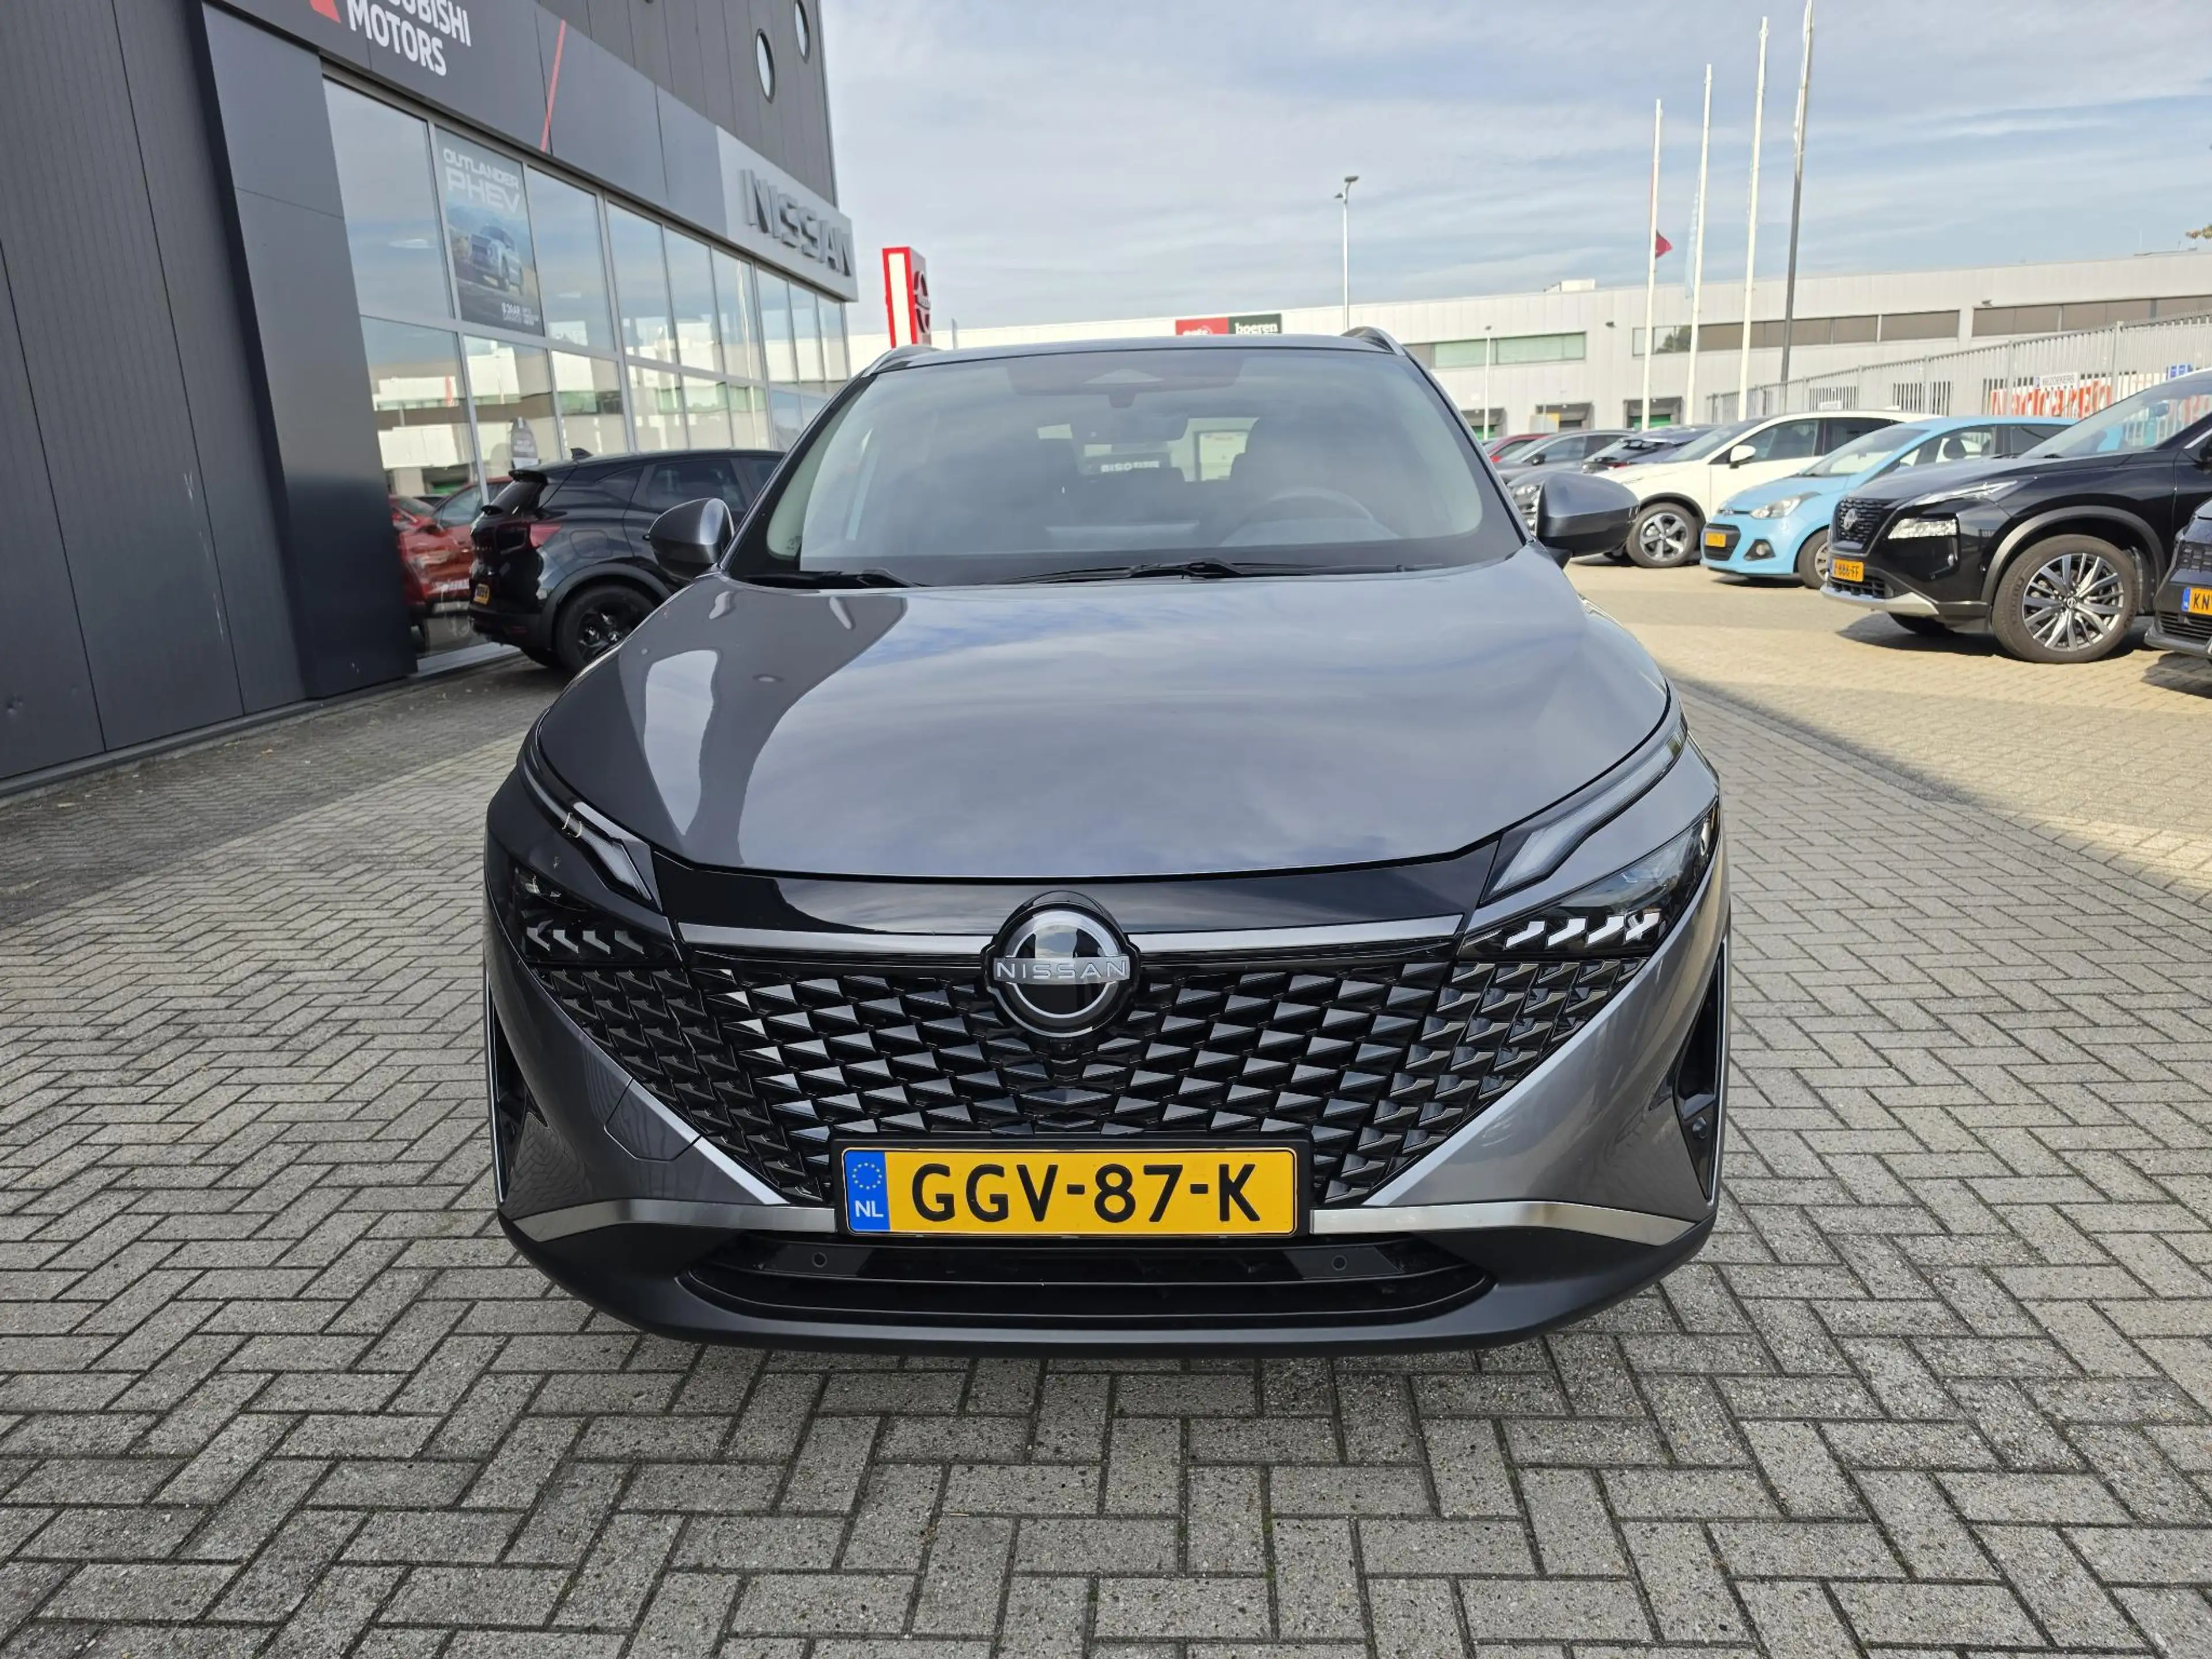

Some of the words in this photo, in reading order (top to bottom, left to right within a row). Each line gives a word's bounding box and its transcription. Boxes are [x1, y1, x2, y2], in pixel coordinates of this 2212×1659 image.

[347, 0, 447, 77] MOTORS
[443, 147, 520, 190] OUTLANDER
[445, 166, 521, 214] PHEV
[739, 169, 852, 277] NISSAN
[2193, 592, 2212, 611] KN
[995, 959, 1127, 980] NISSAN
[854, 1199, 884, 1218] NL
[911, 1162, 1261, 1223] GGV-87-K
